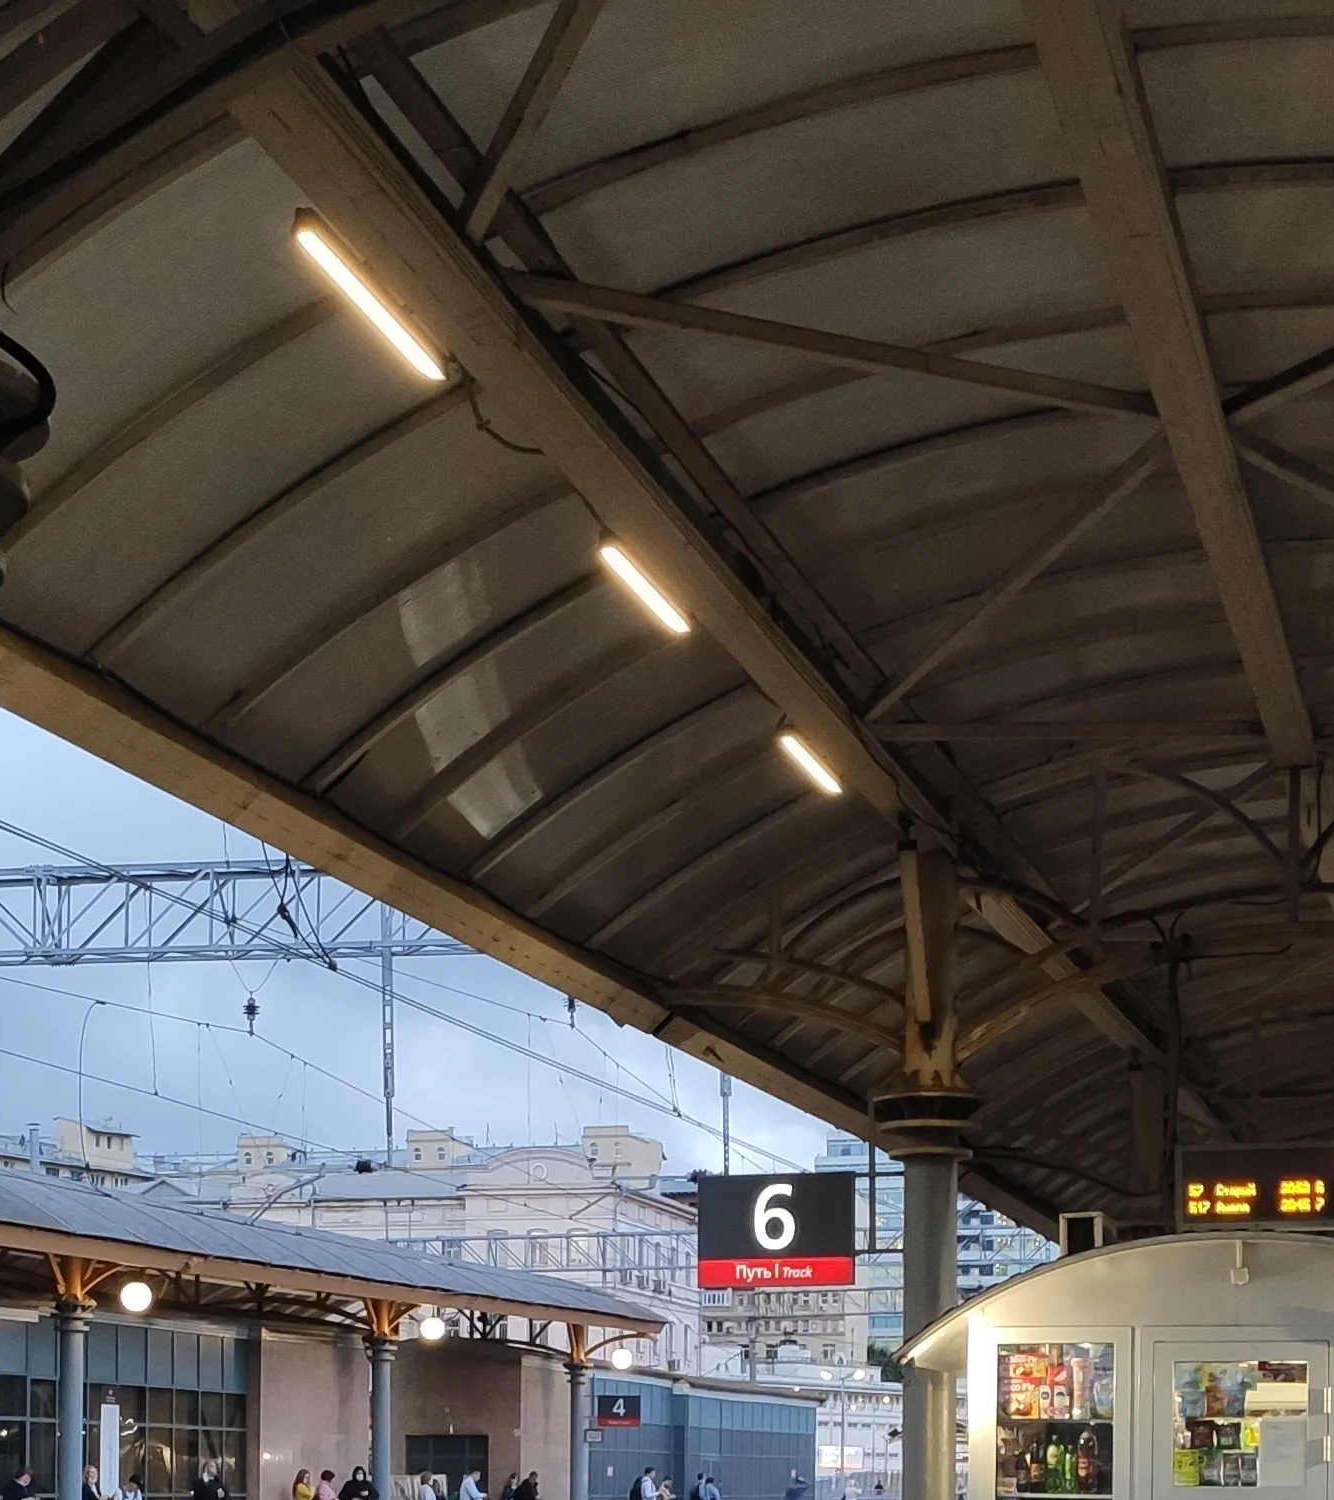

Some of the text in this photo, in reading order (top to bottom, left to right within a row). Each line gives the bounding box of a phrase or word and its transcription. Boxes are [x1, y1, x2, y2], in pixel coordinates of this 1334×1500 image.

[754, 1183, 796, 1250] 6
[735, 1265, 813, 1282] Путь Track
[612, 1398, 626, 1417] 4
